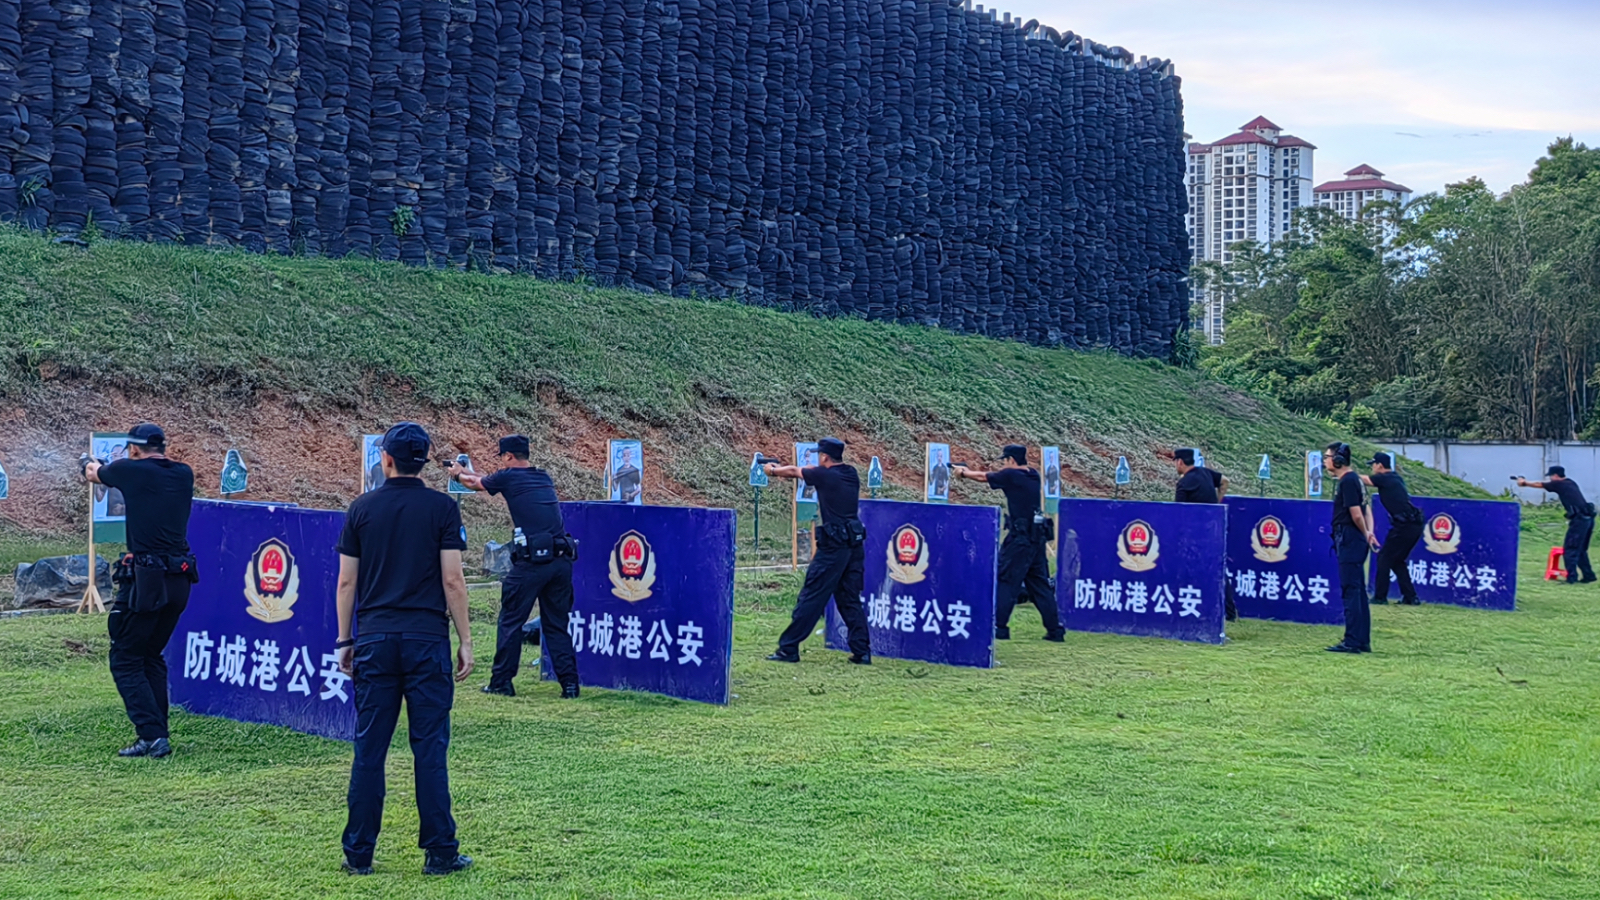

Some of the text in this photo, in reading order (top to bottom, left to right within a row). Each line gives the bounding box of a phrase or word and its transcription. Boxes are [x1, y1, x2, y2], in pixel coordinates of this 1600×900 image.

[1226, 567, 1330, 605] 城港公安
[1389, 559, 1497, 592] 城港公安
[859, 592, 972, 639] 城港公安
[1074, 578, 1202, 618] 防城港公安
[184, 630, 351, 704] 防城港公安
